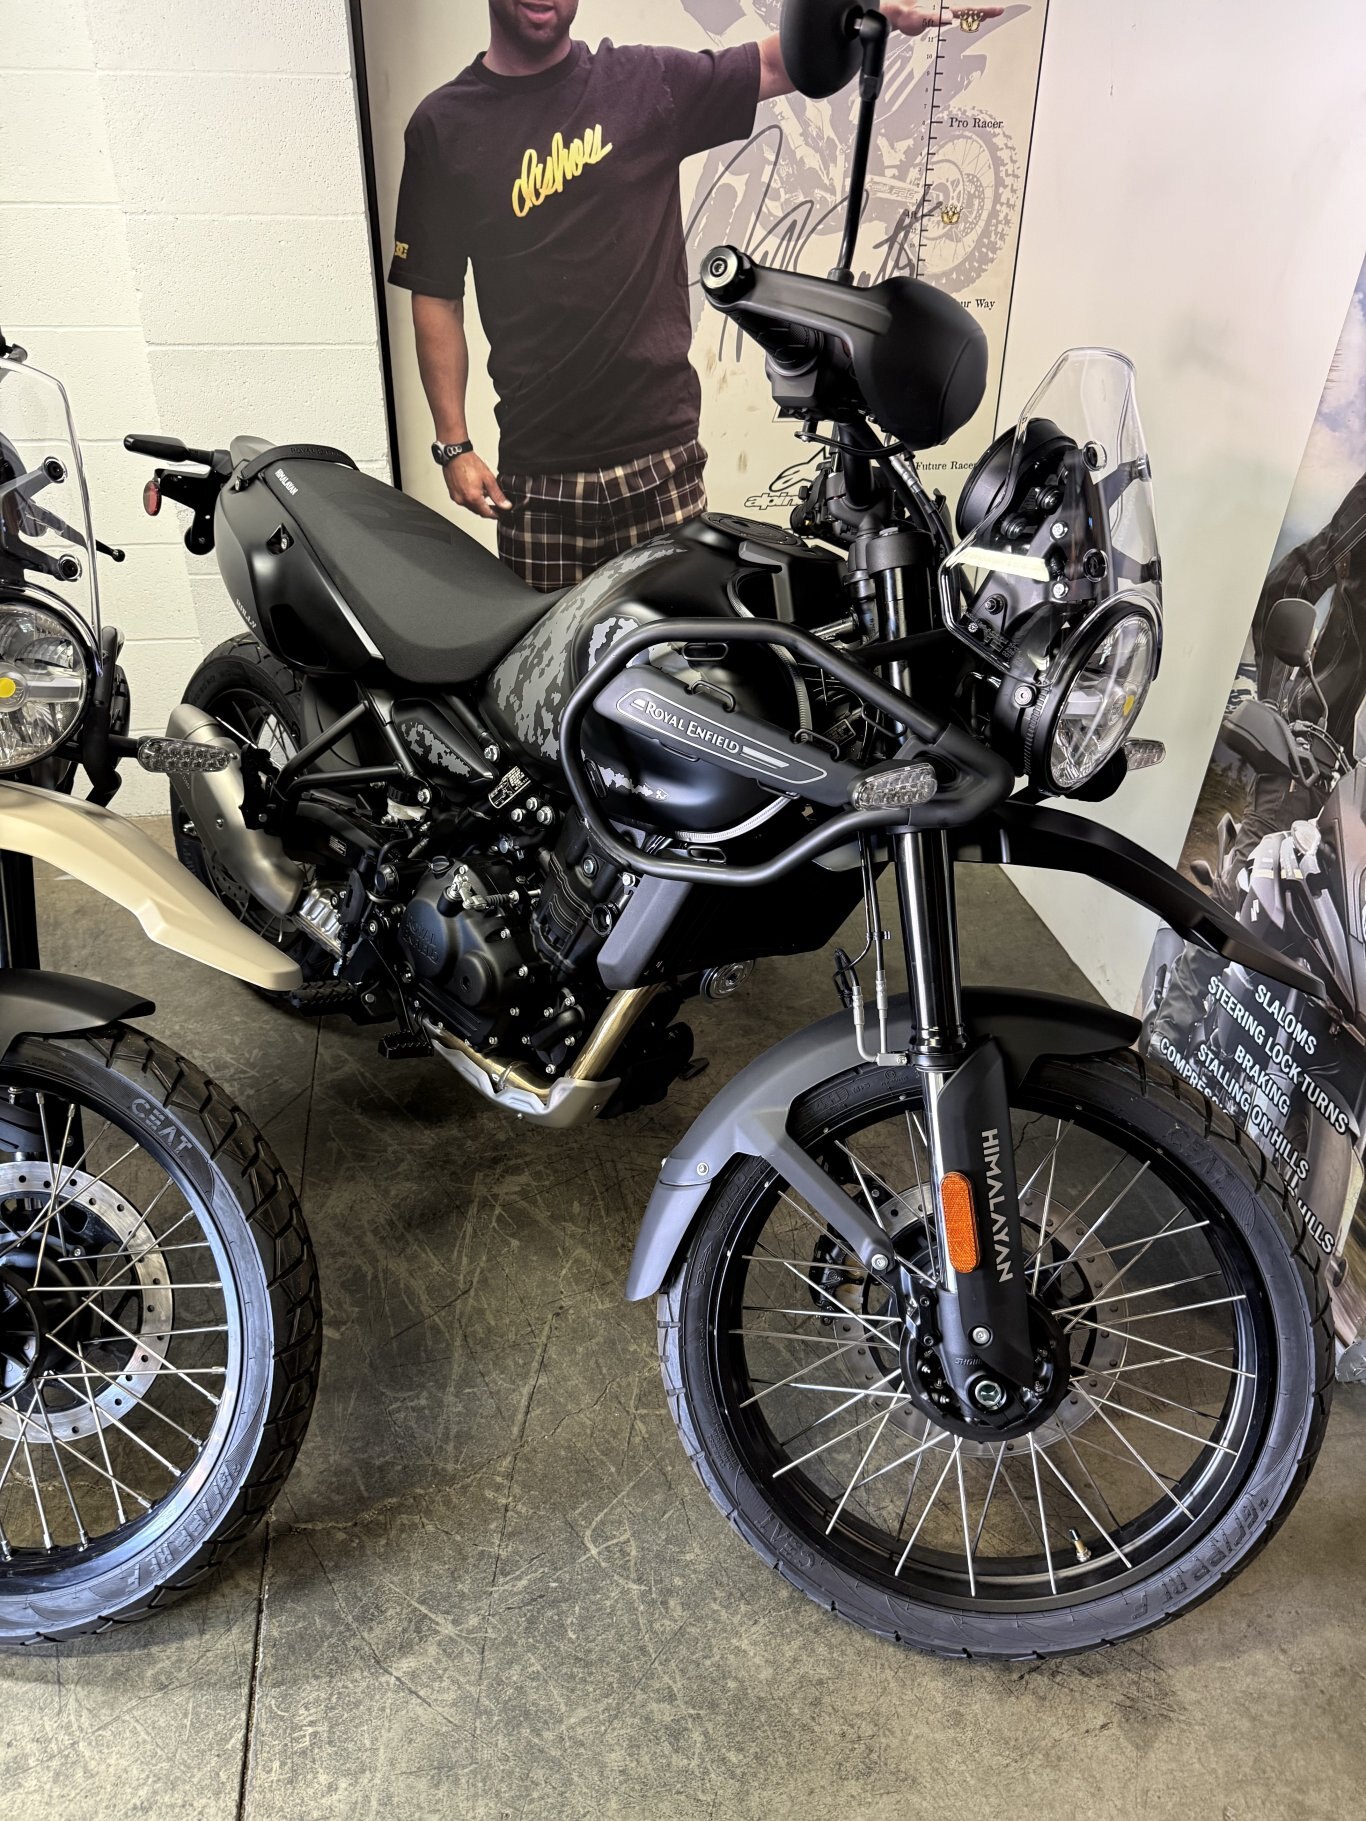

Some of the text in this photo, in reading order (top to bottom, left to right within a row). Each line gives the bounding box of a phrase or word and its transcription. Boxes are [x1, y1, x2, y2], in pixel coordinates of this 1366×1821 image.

[949, 117, 1003, 129] Pro Racer
[975, 298, 995, 311] Way
[915, 461, 947, 471] Future
[645, 702, 740, 754] ROYAL ENFIELD
[1255, 984, 1317, 1055] SLALOMS
[1207, 976, 1349, 1134] STEERING LOCK TURNS
[1233, 1044, 1290, 1116] BRAKING
[131, 1098, 193, 1155] CEAT
[1197, 1043, 1251, 1112] STALLING
[1250, 1105, 1272, 1137] ON
[1270, 1127, 1309, 1180] HILLS
[981, 1128, 1013, 1283] HIMALAYAN
